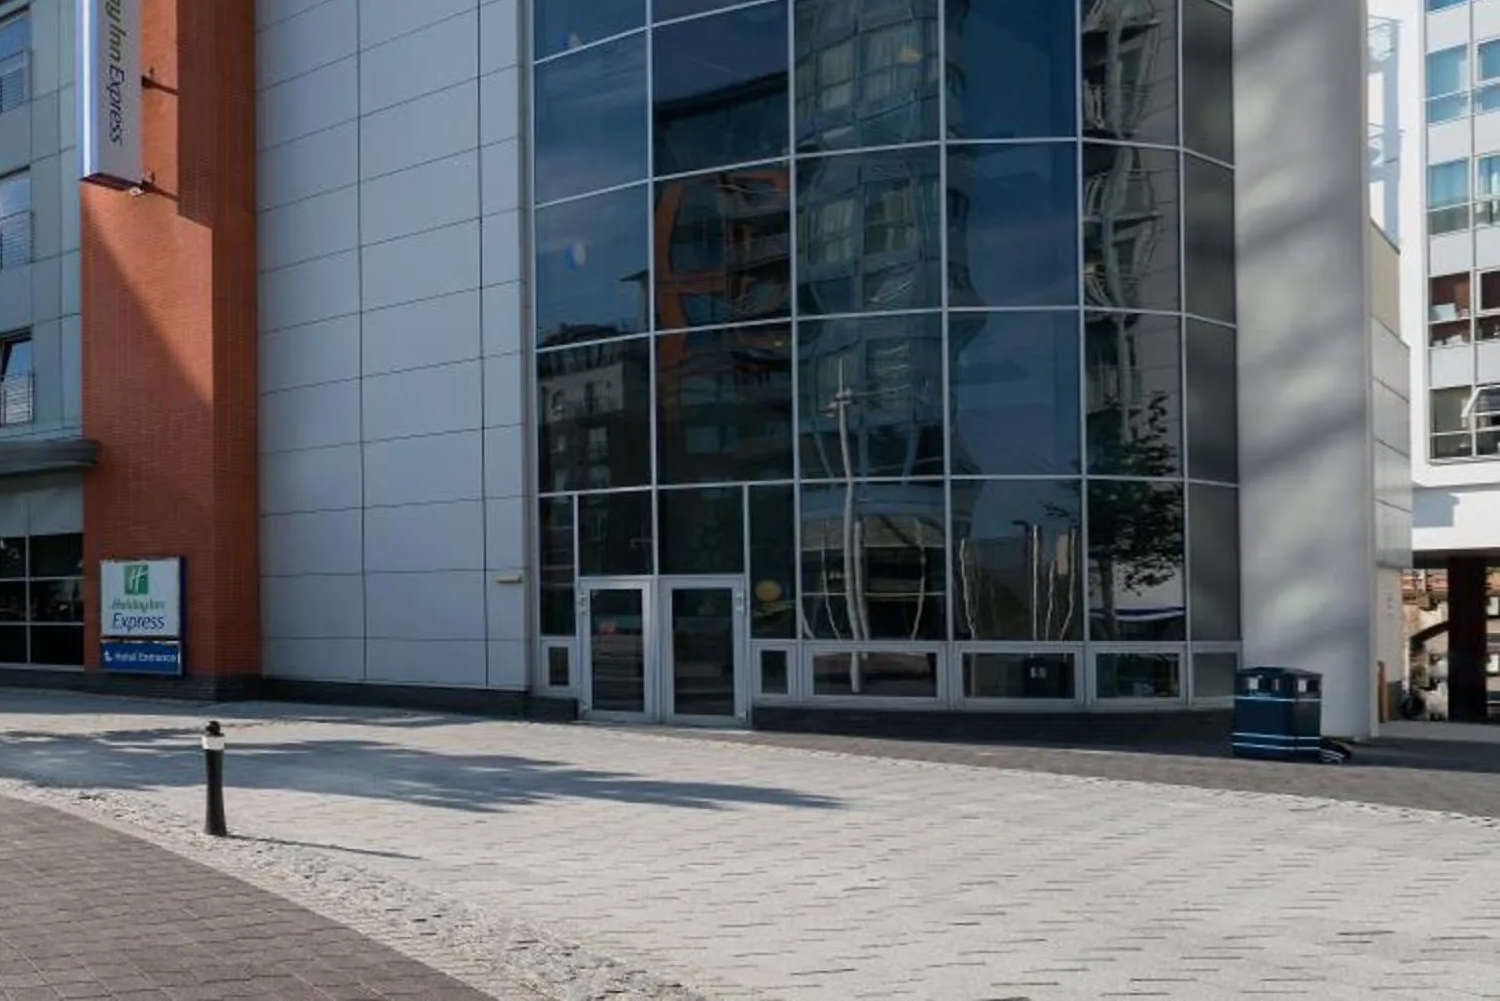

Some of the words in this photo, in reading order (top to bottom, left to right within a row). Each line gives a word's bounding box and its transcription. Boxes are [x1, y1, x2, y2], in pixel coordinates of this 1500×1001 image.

[109, 23, 127, 63] Inn
[106, 64, 125, 146] Express
[111, 599, 148, 613] Holiday
[149, 599, 165, 609] Inn
[112, 612, 165, 632] Express
